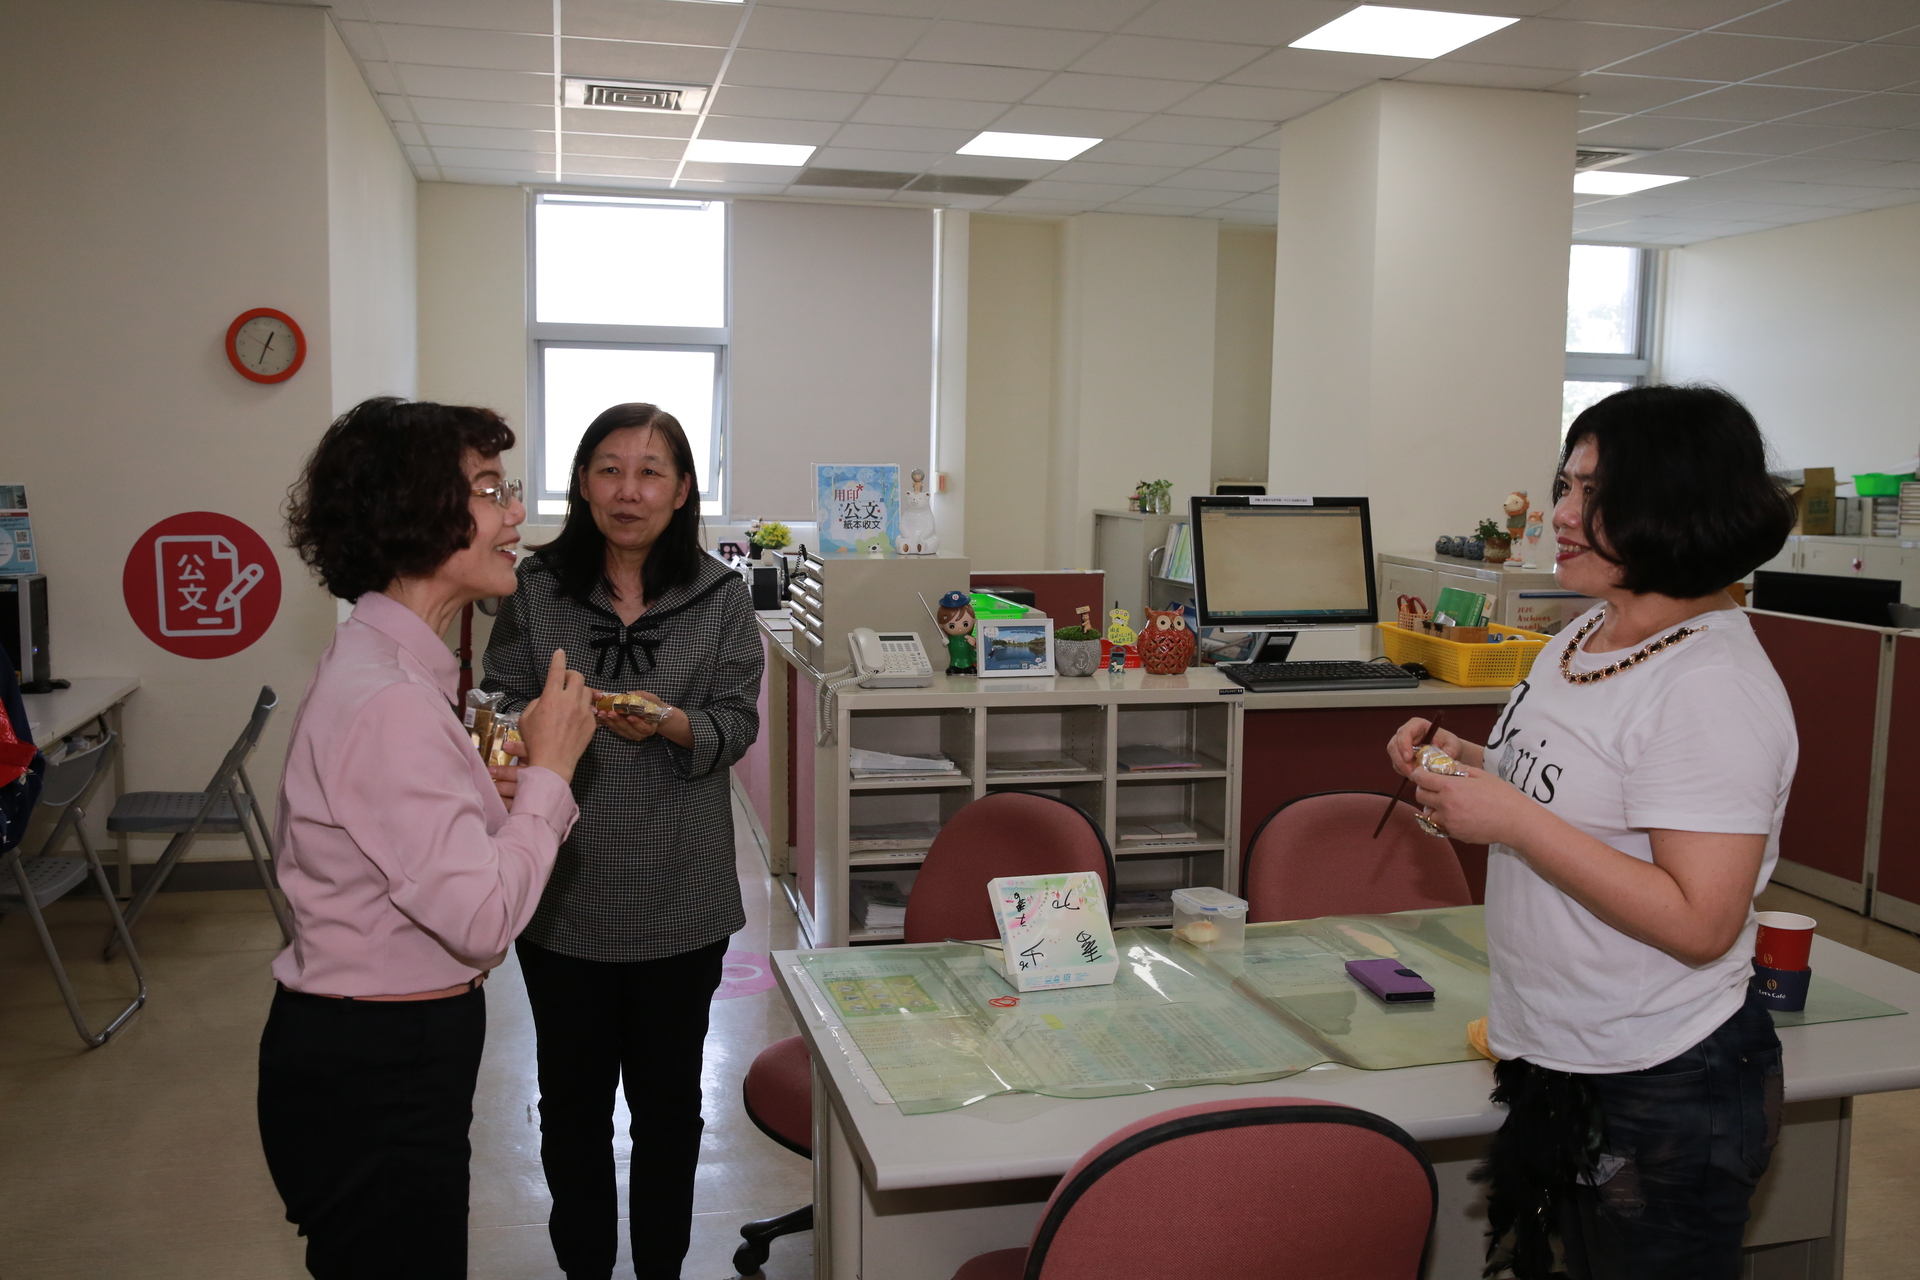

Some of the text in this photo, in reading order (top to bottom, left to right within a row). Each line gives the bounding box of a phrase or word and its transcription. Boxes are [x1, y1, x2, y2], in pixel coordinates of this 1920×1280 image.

[834, 489, 859, 502] 用印
[844, 501, 879, 520] 公文
[843, 520, 881, 530] 紙本收文
[177, 554, 208, 611] 公文
